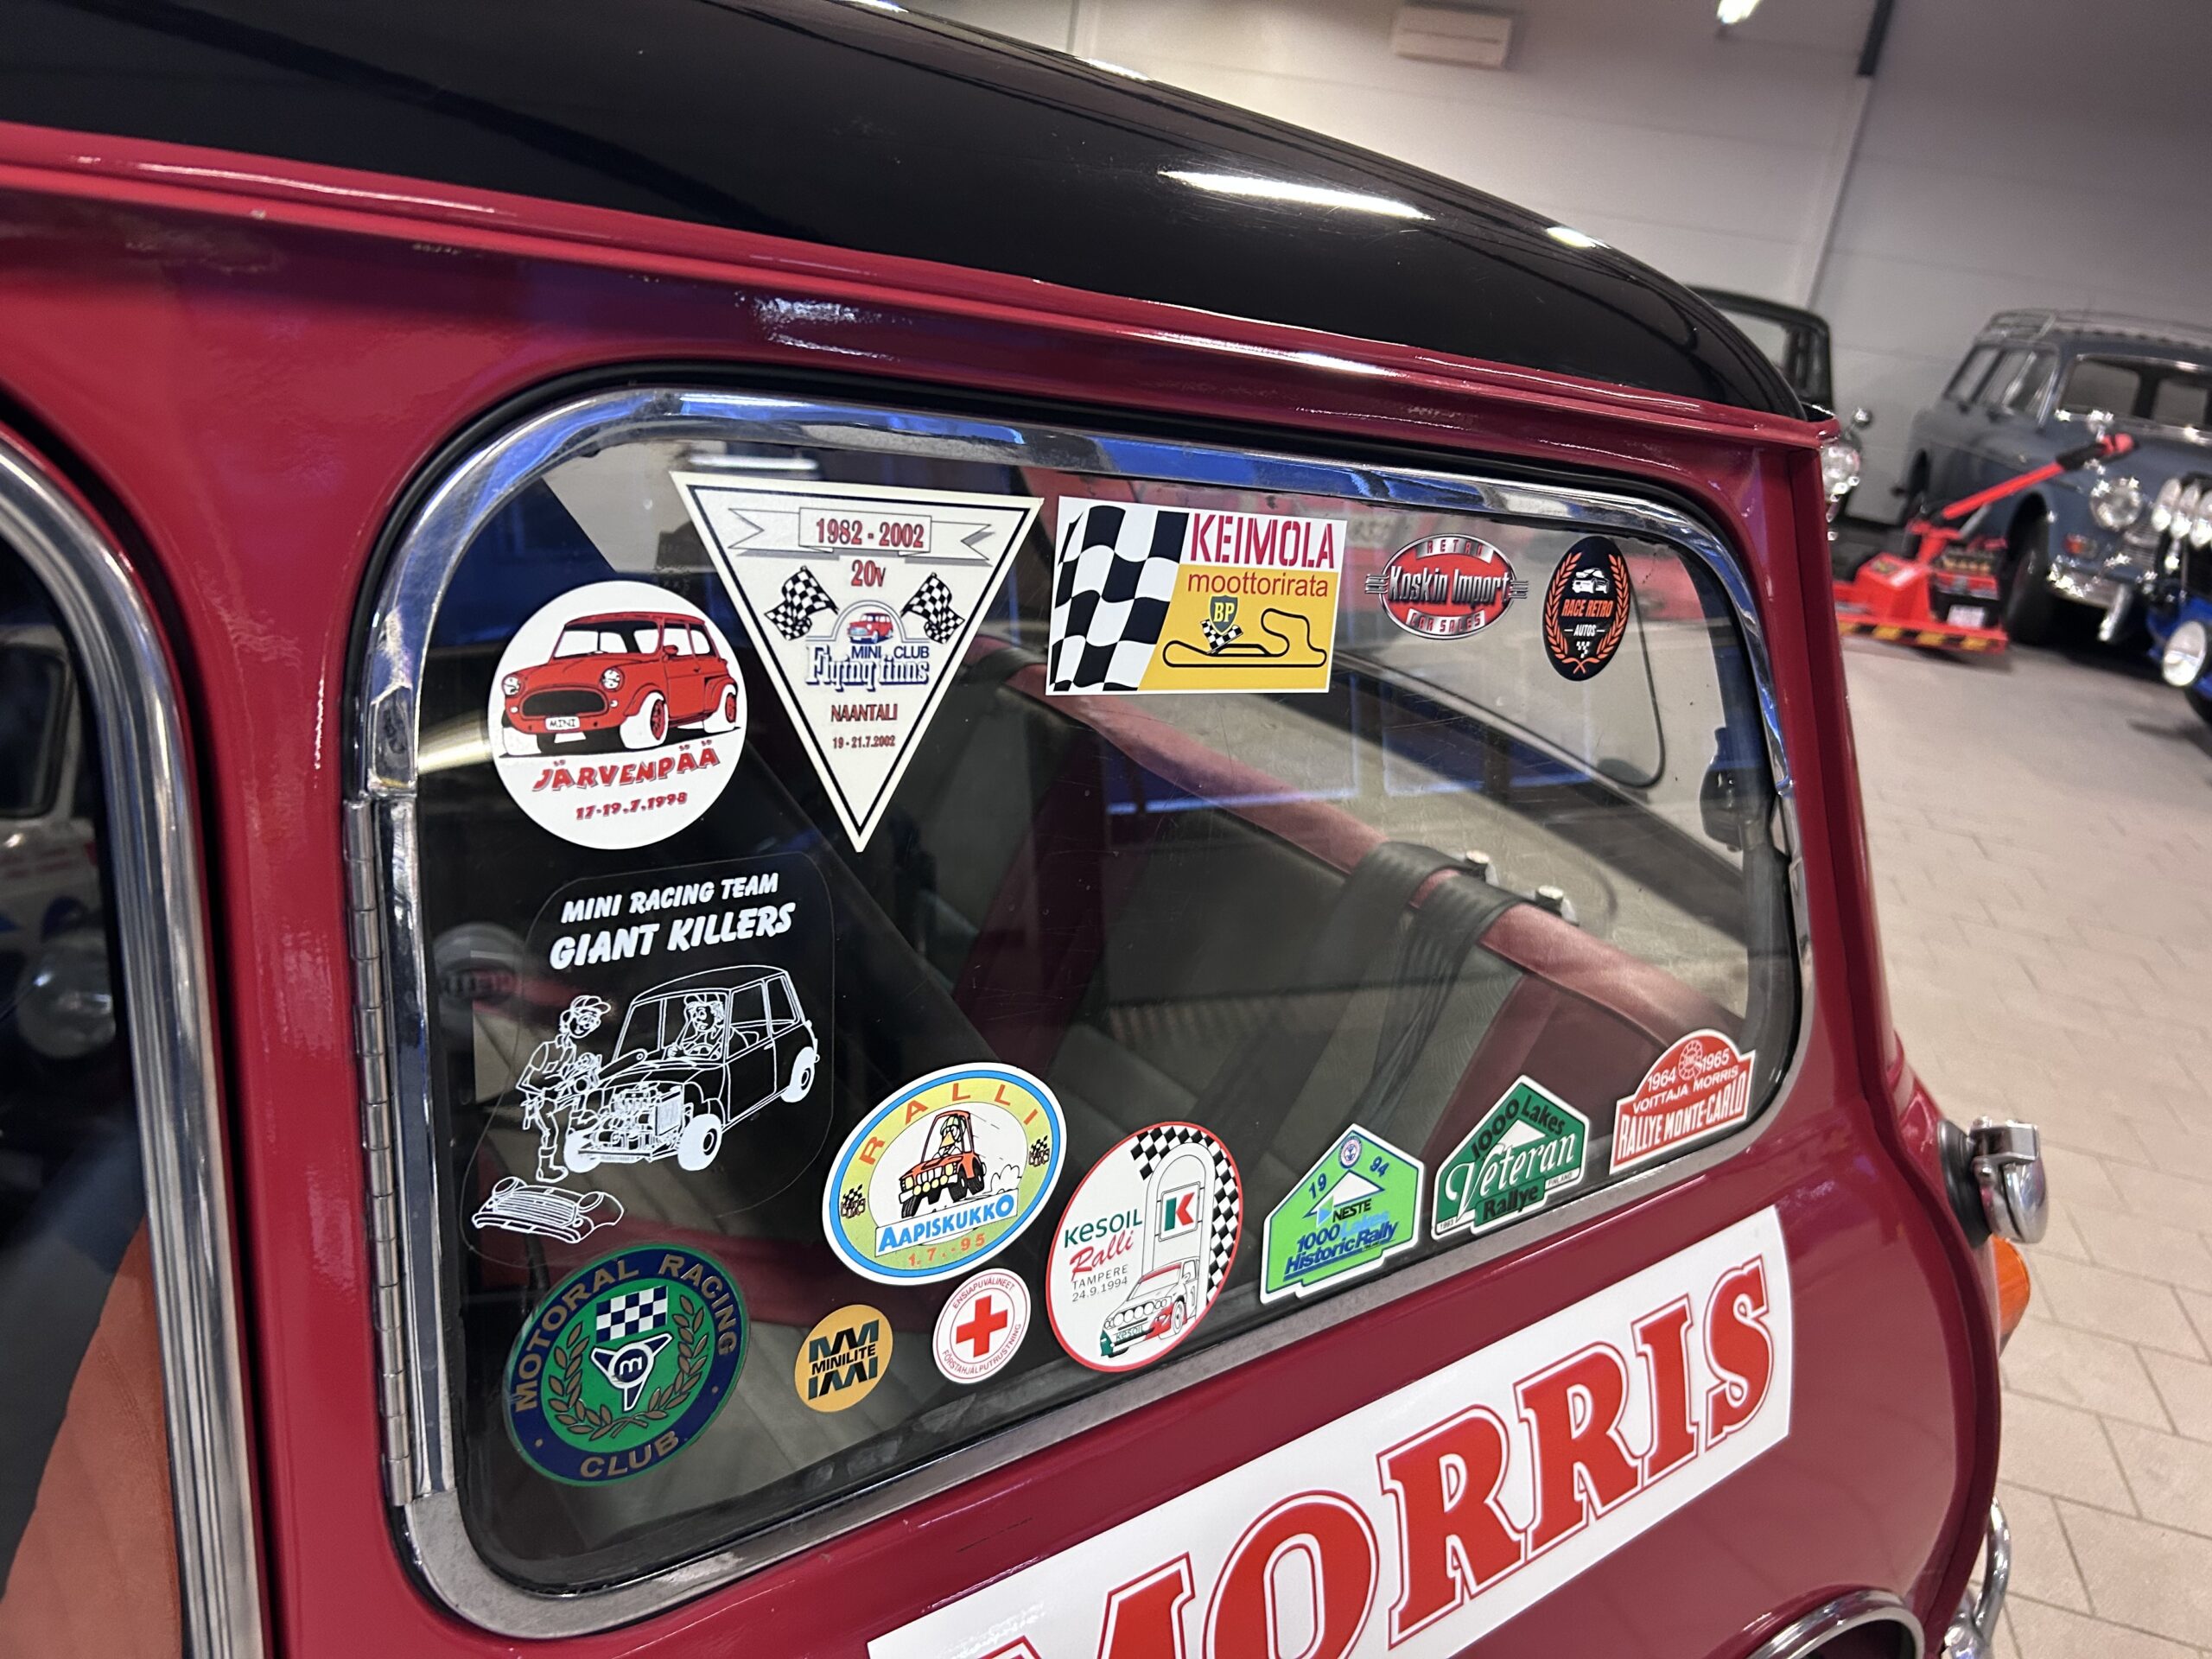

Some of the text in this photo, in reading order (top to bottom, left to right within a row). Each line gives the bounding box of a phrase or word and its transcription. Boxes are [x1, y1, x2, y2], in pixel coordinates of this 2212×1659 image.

[816, 518, 862, 545] 1982
[879, 521, 925, 549] 2002
[1190, 512, 1335, 569] KEIMOLA
[1427, 539, 1484, 554] RETRO
[1187, 571, 1328, 597] moottorirata
[1389, 565, 1510, 609] Koskin Import
[1213, 601, 1235, 623] BP
[1411, 611, 1482, 632] CAR SALES
[1561, 599, 1614, 618] RACE RETRO
[1574, 624, 1597, 637] AUTOS
[804, 645, 877, 692] Flying
[851, 645, 930, 659] MINI CLUB
[549, 718, 576, 728] MINI
[830, 703, 898, 722] NAANTALI
[532, 740, 721, 791] JÄRVENPÄÄ
[575, 791, 689, 820] 17-19.7.1998
[561, 873, 779, 924] MINI RACING TEAM
[550, 902, 796, 969] GIANT KILLERS
[1647, 1048, 1730, 1092] 1964 1965
[1632, 1065, 1739, 1115] VOITTAJA MORRIS
[859, 1083, 1038, 1165] RALLI
[1470, 1095, 1566, 1160] 1000 Lakes
[1617, 1071, 1747, 1160] RALLYE MONTE-CARLO
[1445, 1133, 1576, 1223] Veteran
[1332, 1198, 1371, 1223] NESTE
[1482, 1185, 1538, 1221] Rallye
[1069, 1230, 1134, 1281] Ralli
[1297, 1224, 1341, 1253] 1000
[1071, 1275, 1128, 1302] 24.9.1994
[1072, 1264, 1128, 1291] TAMPERE
[516, 1254, 737, 1413] MOTORAL RACING
[811, 1344, 876, 1376] MINILITE
[580, 1430, 679, 1478] CLUB
